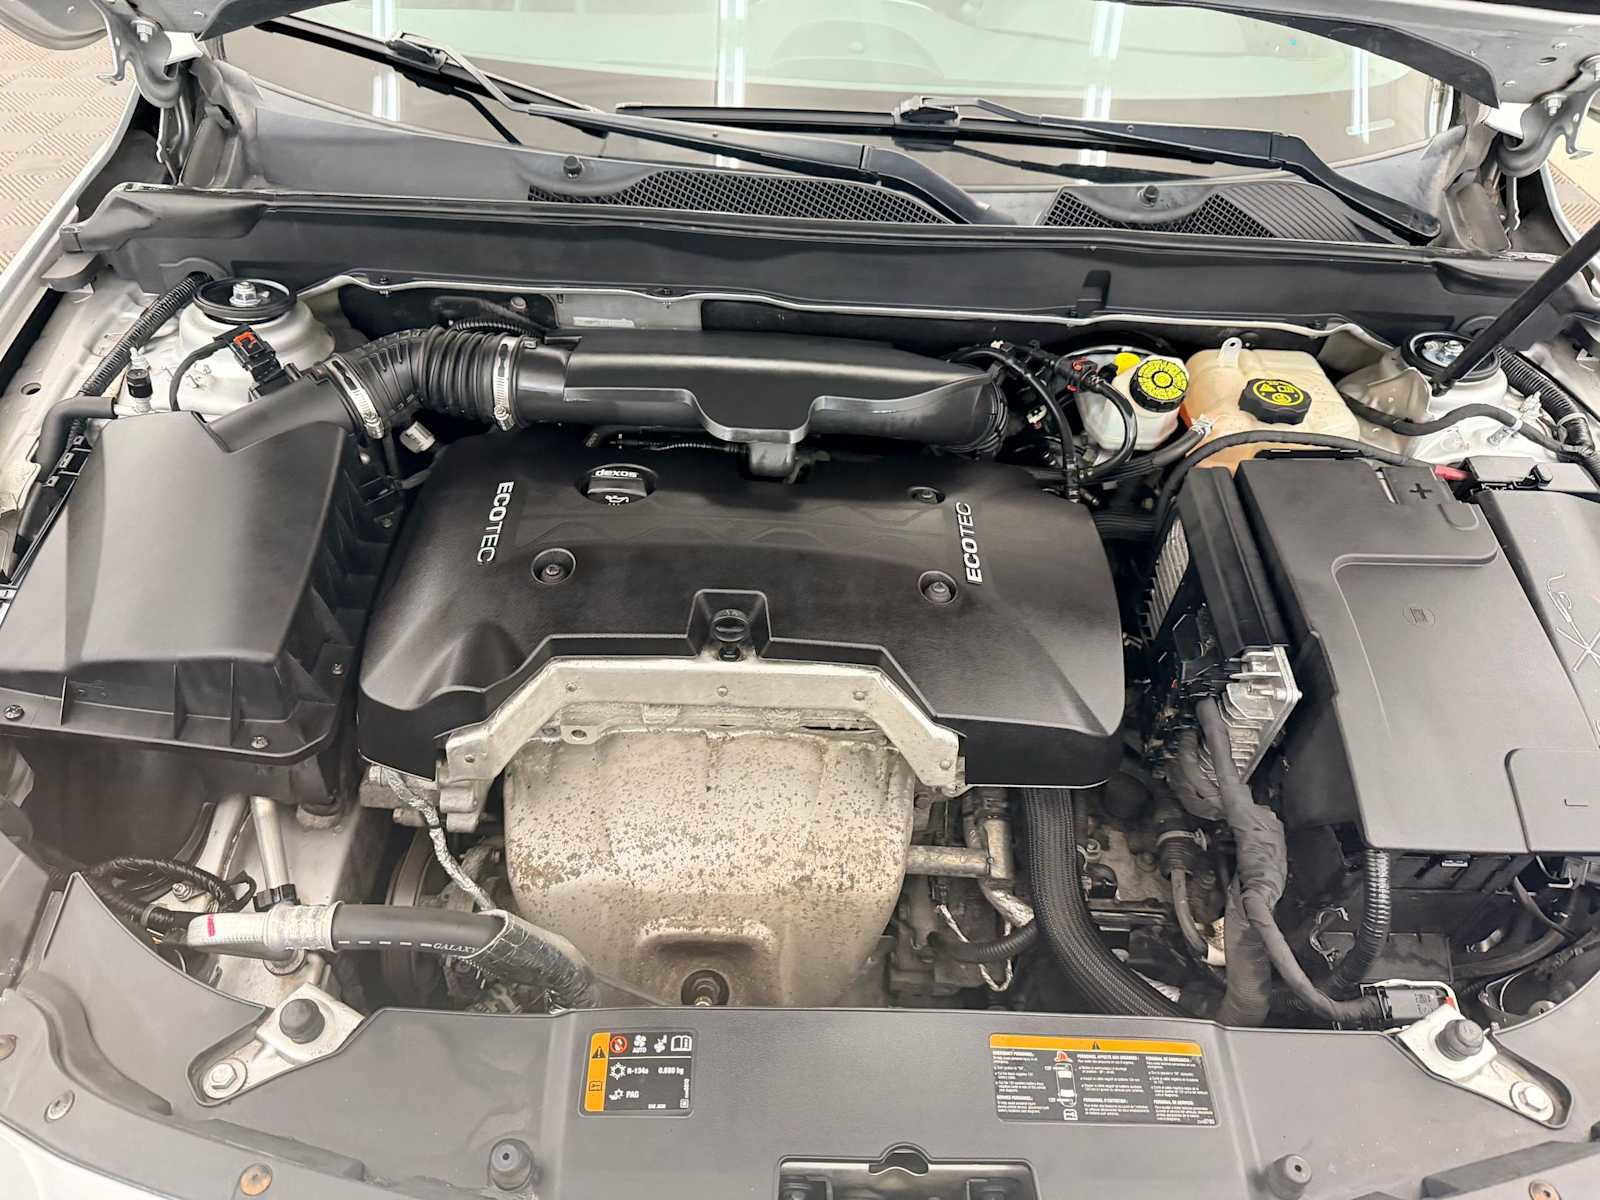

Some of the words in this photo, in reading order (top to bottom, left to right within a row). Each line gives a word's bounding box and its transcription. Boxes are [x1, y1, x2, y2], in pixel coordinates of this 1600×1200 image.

[594, 469, 640, 478] dexos
[476, 481, 515, 563] ECOTEC
[955, 501, 983, 583] ECOTEC
[433, 943, 480, 954] GALAXY
